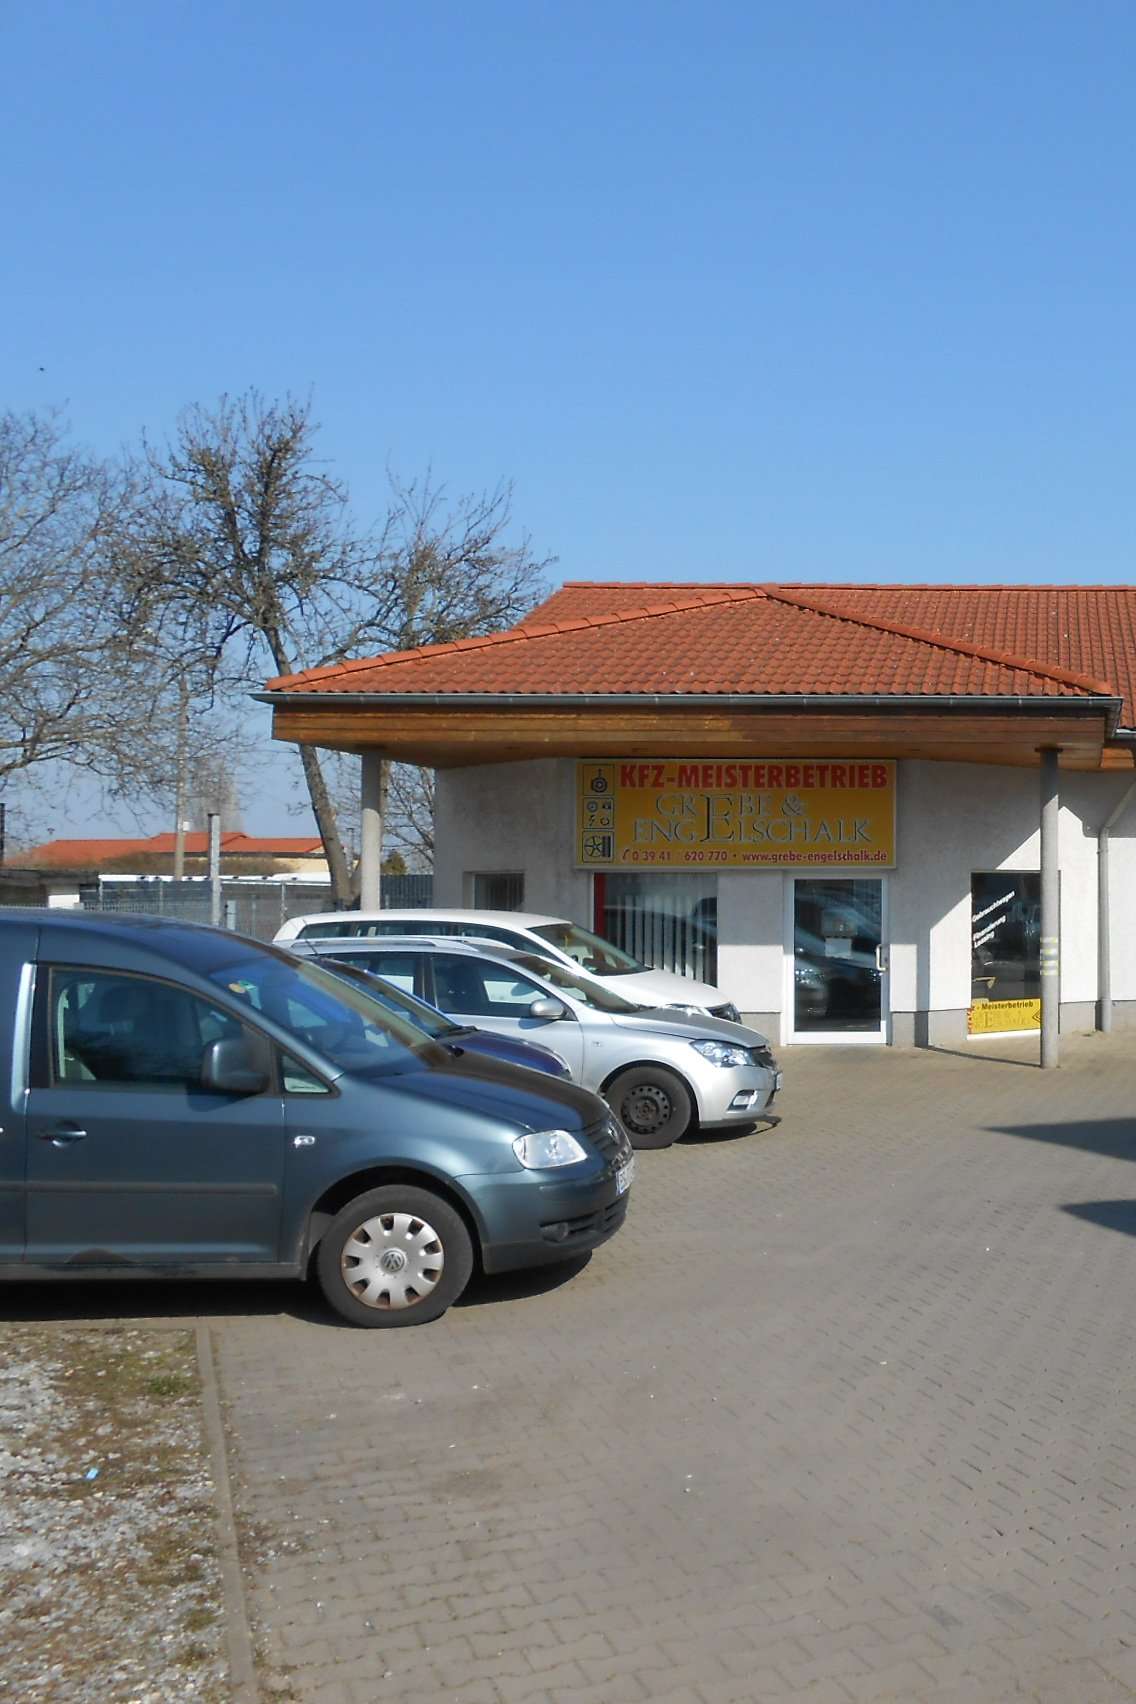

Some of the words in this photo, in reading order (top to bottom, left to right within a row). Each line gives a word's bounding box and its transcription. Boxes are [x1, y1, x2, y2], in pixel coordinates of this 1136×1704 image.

[620, 764, 887, 789] KFZ-MEISTERBETRIEB
[656, 793, 773, 828] GREBE
[781, 793, 804, 817] &
[634, 810, 872, 842] ENGELSCHALK
[743, 850, 887, 863] www.grebe-engelschalk.de
[982, 1000, 1034, 1009] Meisterbetrieb
